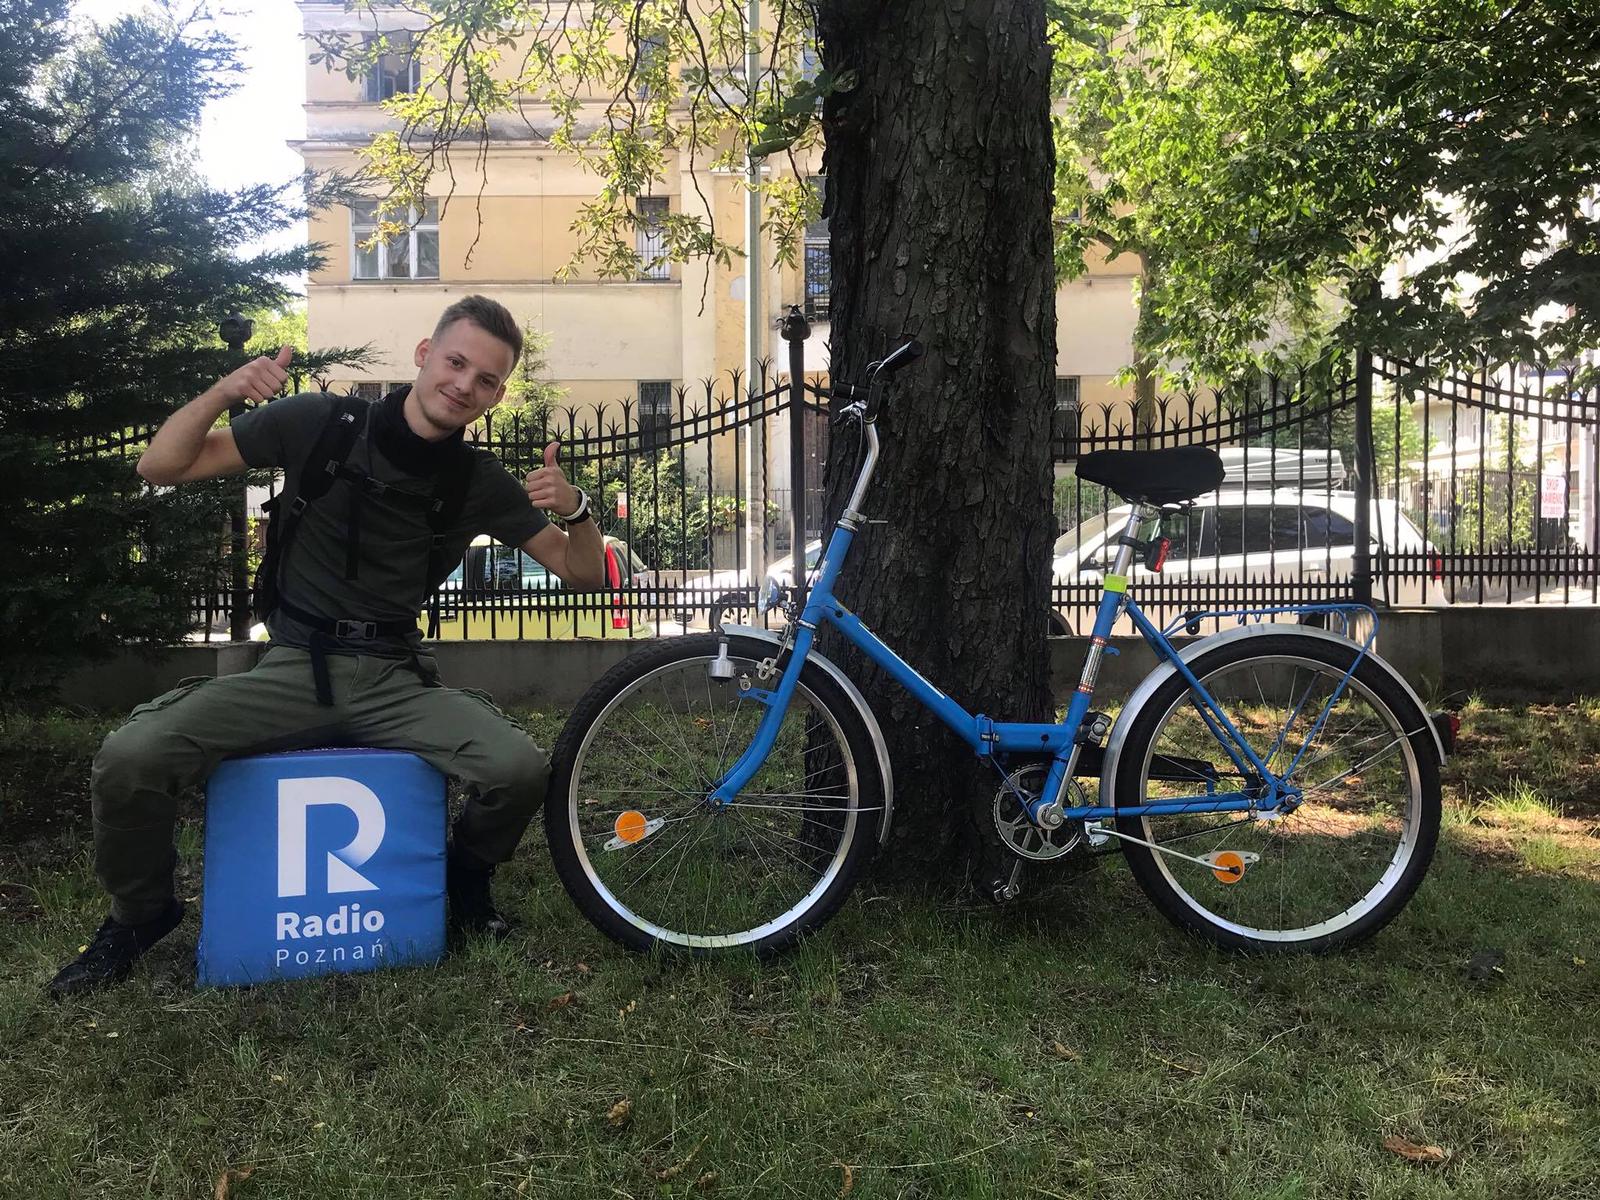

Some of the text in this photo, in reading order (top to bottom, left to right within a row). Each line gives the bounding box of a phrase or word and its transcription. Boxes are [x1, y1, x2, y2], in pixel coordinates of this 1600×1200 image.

[277, 776, 386, 898] R
[276, 903, 385, 941] Radio
[276, 938, 384, 968] Poznań
